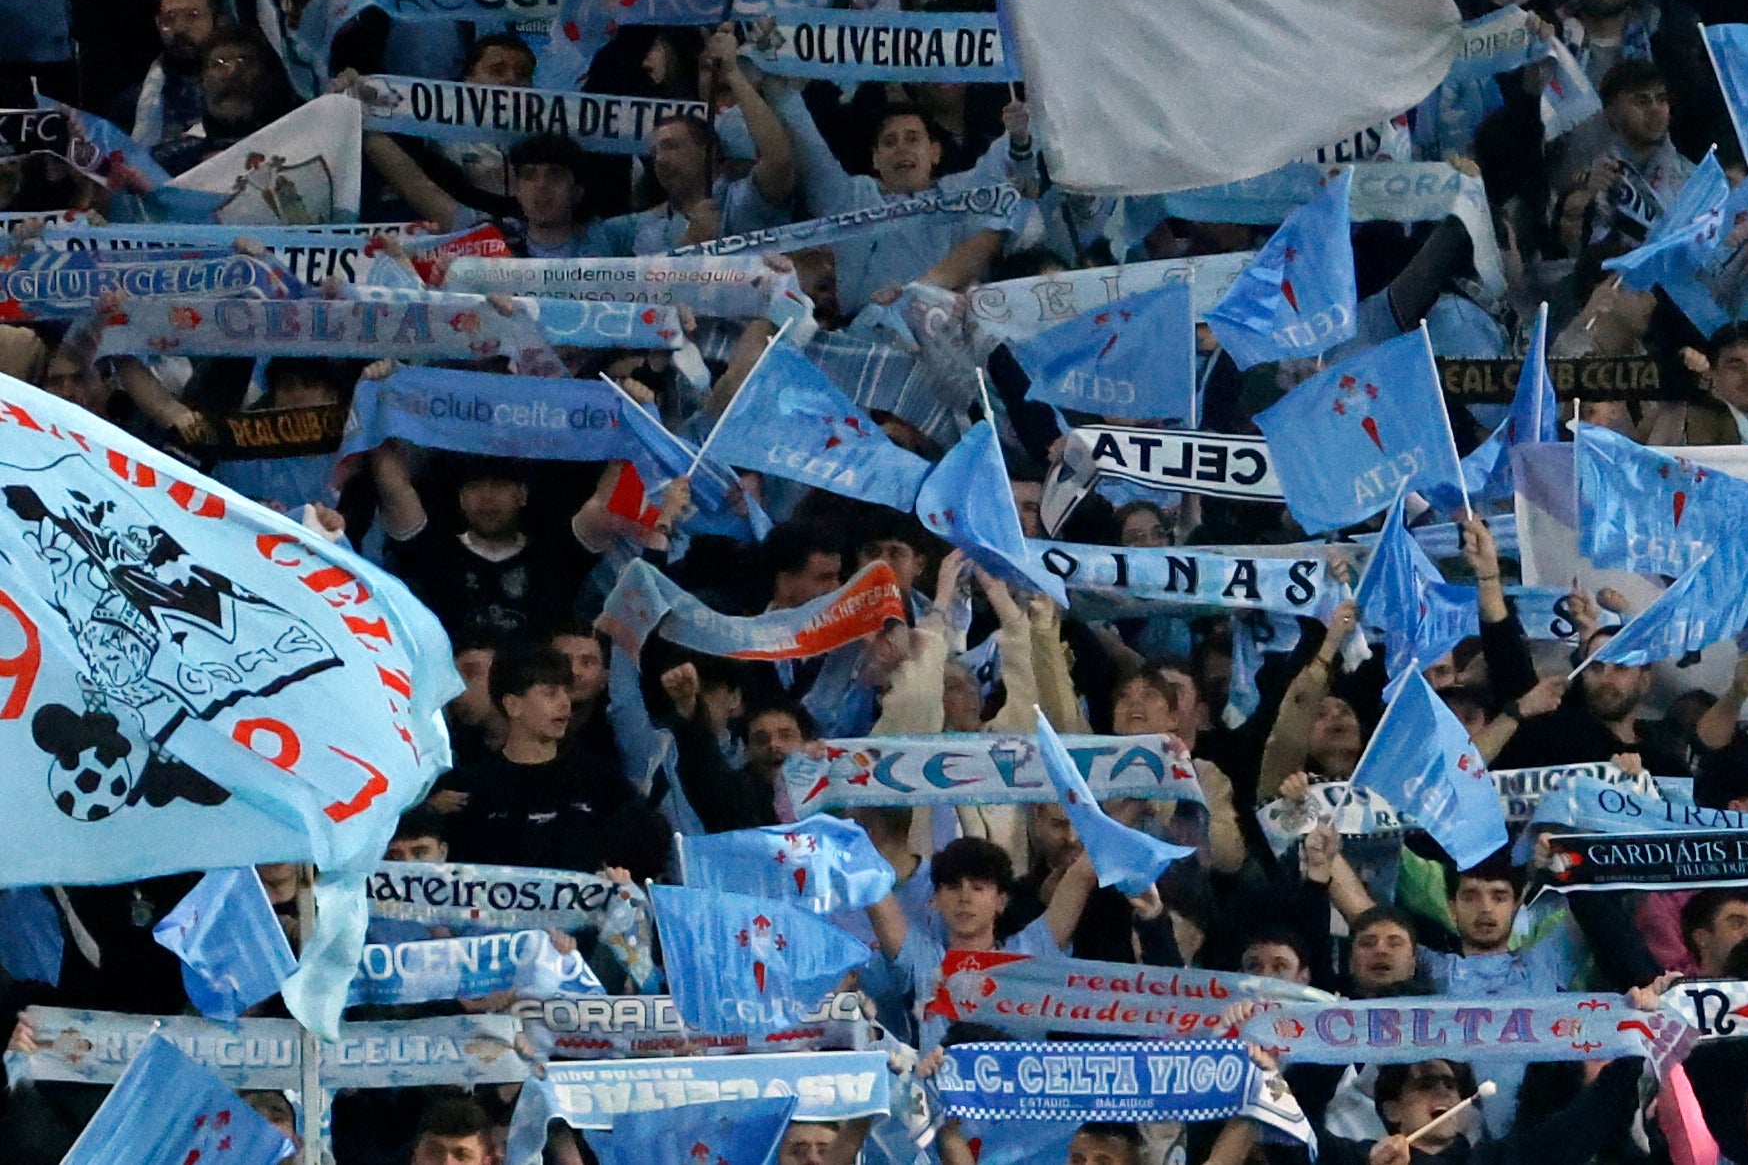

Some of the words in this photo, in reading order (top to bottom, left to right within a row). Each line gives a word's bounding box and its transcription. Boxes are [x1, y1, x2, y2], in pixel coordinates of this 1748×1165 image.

[795, 24, 945, 68] OLIVEIRA
[957, 25, 994, 67] DE
[411, 82, 567, 135] OLIVEIRA
[578, 101, 630, 138] DE
[283, 246, 359, 286] TEIS
[541, 266, 636, 284] puidemos
[642, 266, 746, 287] conseguilo
[215, 302, 432, 344] CELTA
[872, 740, 1167, 793] CELTA
[1598, 788, 1643, 824] OS
[1067, 971, 1229, 1001] realclub
[994, 996, 1223, 1034] celtadevigo
[337, 1038, 463, 1067] CELTA
[1017, 1056, 1140, 1095] CELTA
[1149, 1054, 1244, 1093] VIGO
